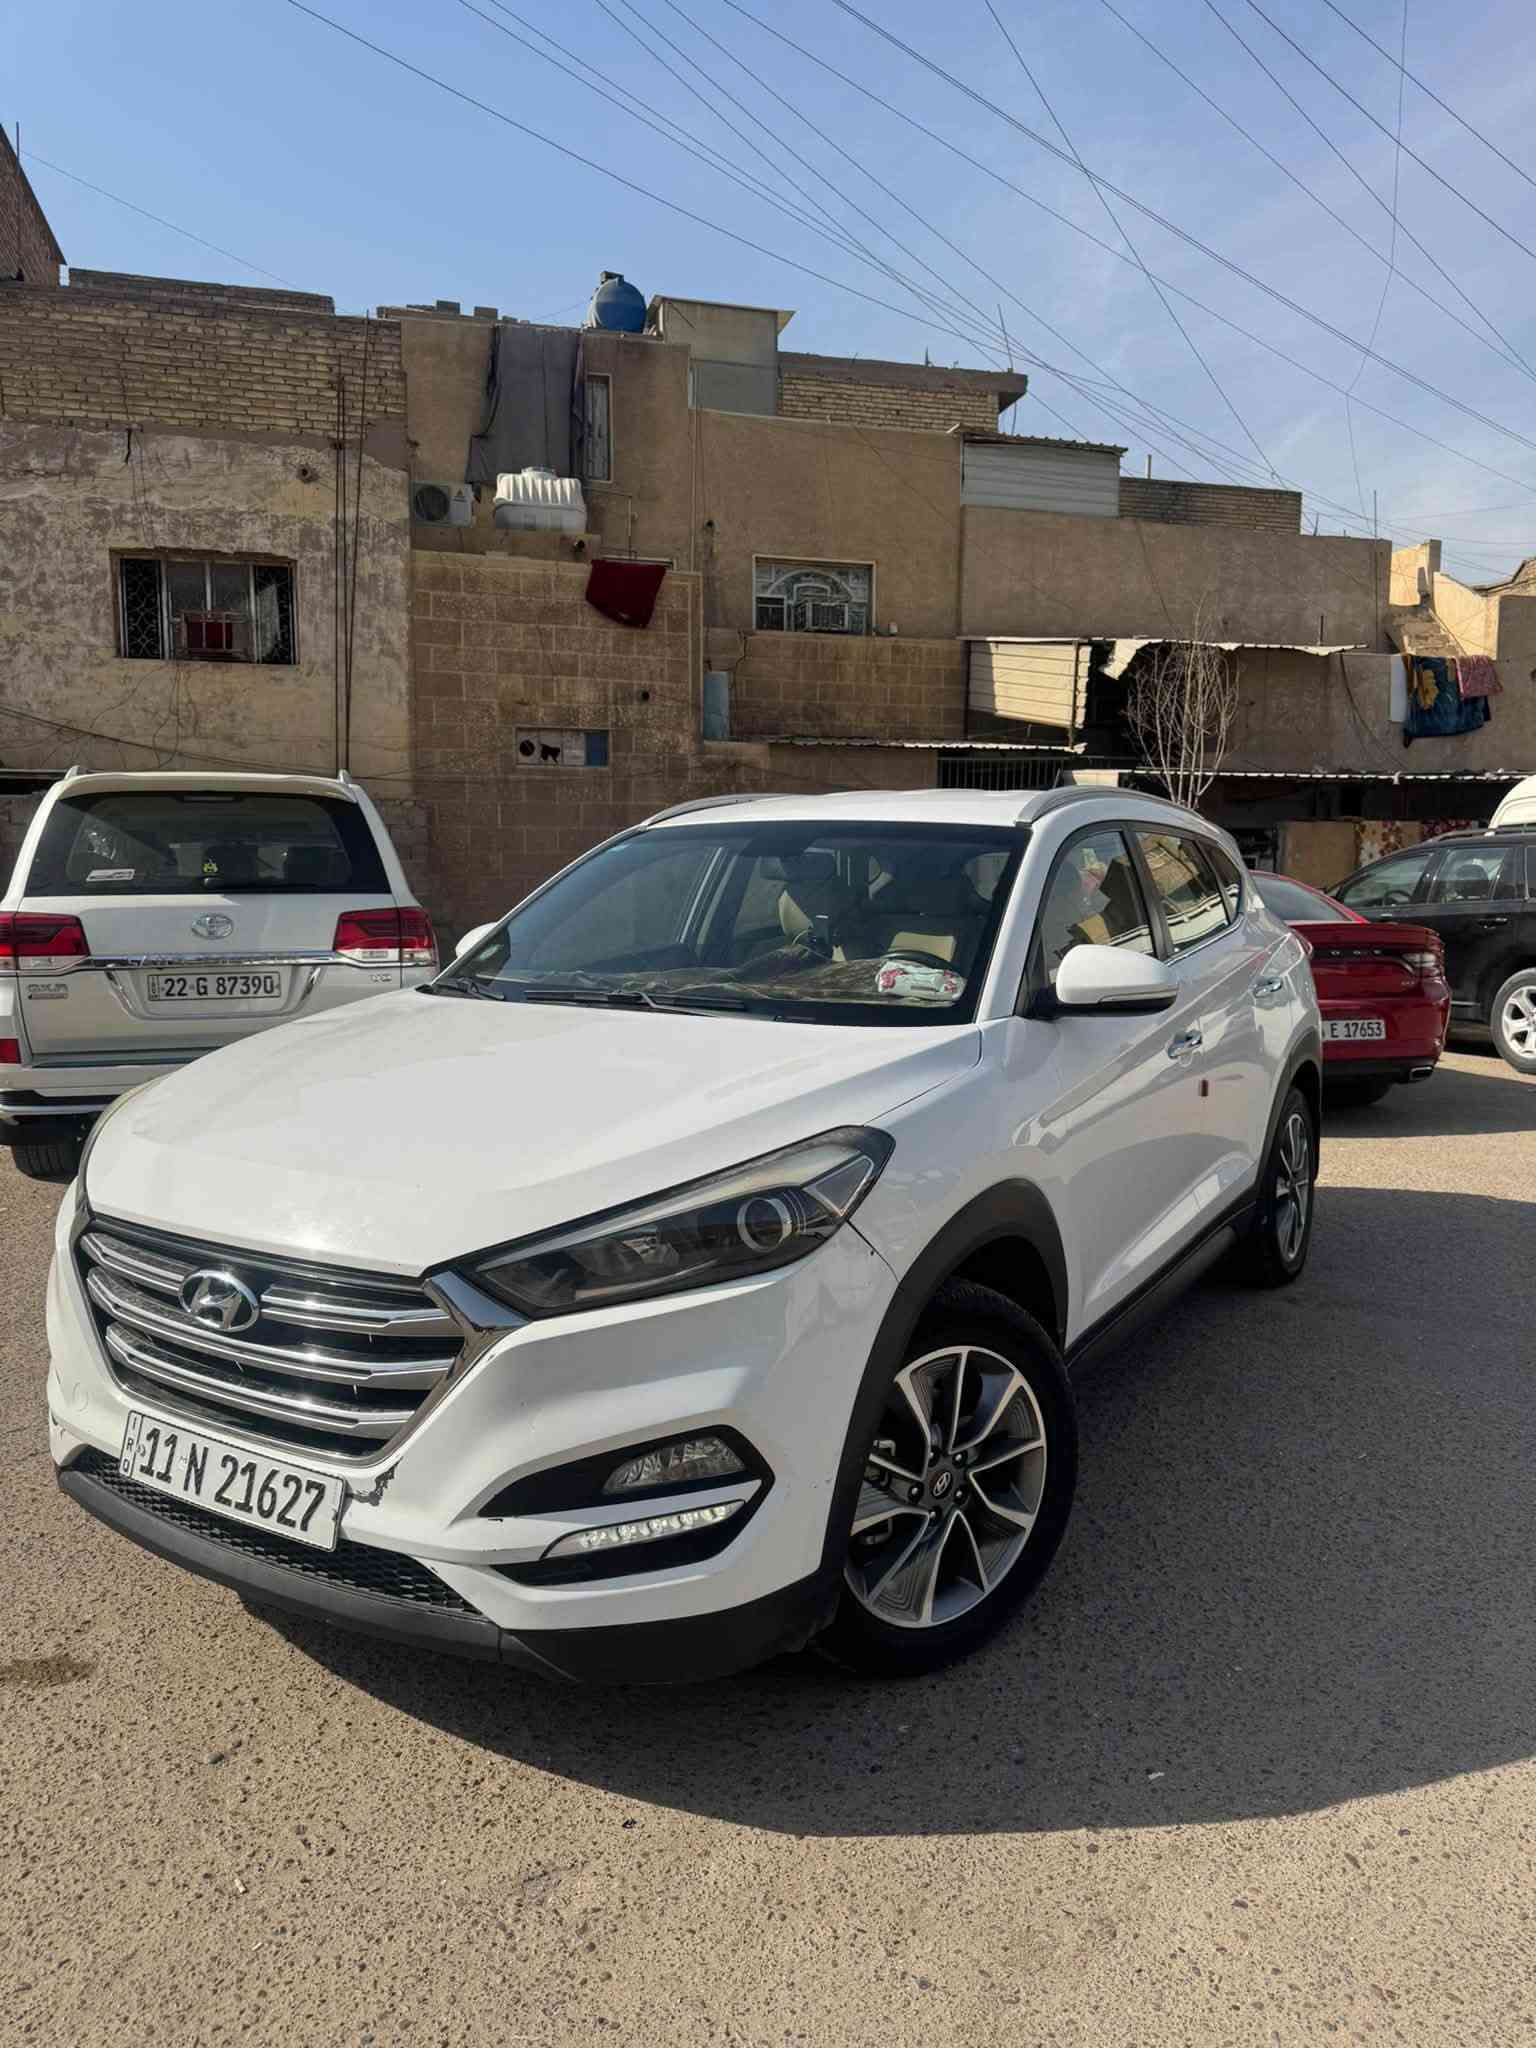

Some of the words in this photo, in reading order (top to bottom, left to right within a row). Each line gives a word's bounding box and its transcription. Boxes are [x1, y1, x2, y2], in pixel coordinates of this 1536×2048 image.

[164, 977, 188, 997] 22
[196, 977, 208, 996] G
[216, 976, 274, 995] 87390
[1330, 1022, 1338, 1038] E
[1344, 1021, 1383, 1038] 17653
[139, 1427, 178, 1484] 11
[183, 1442, 209, 1496] N
[214, 1453, 326, 1532] 21627
